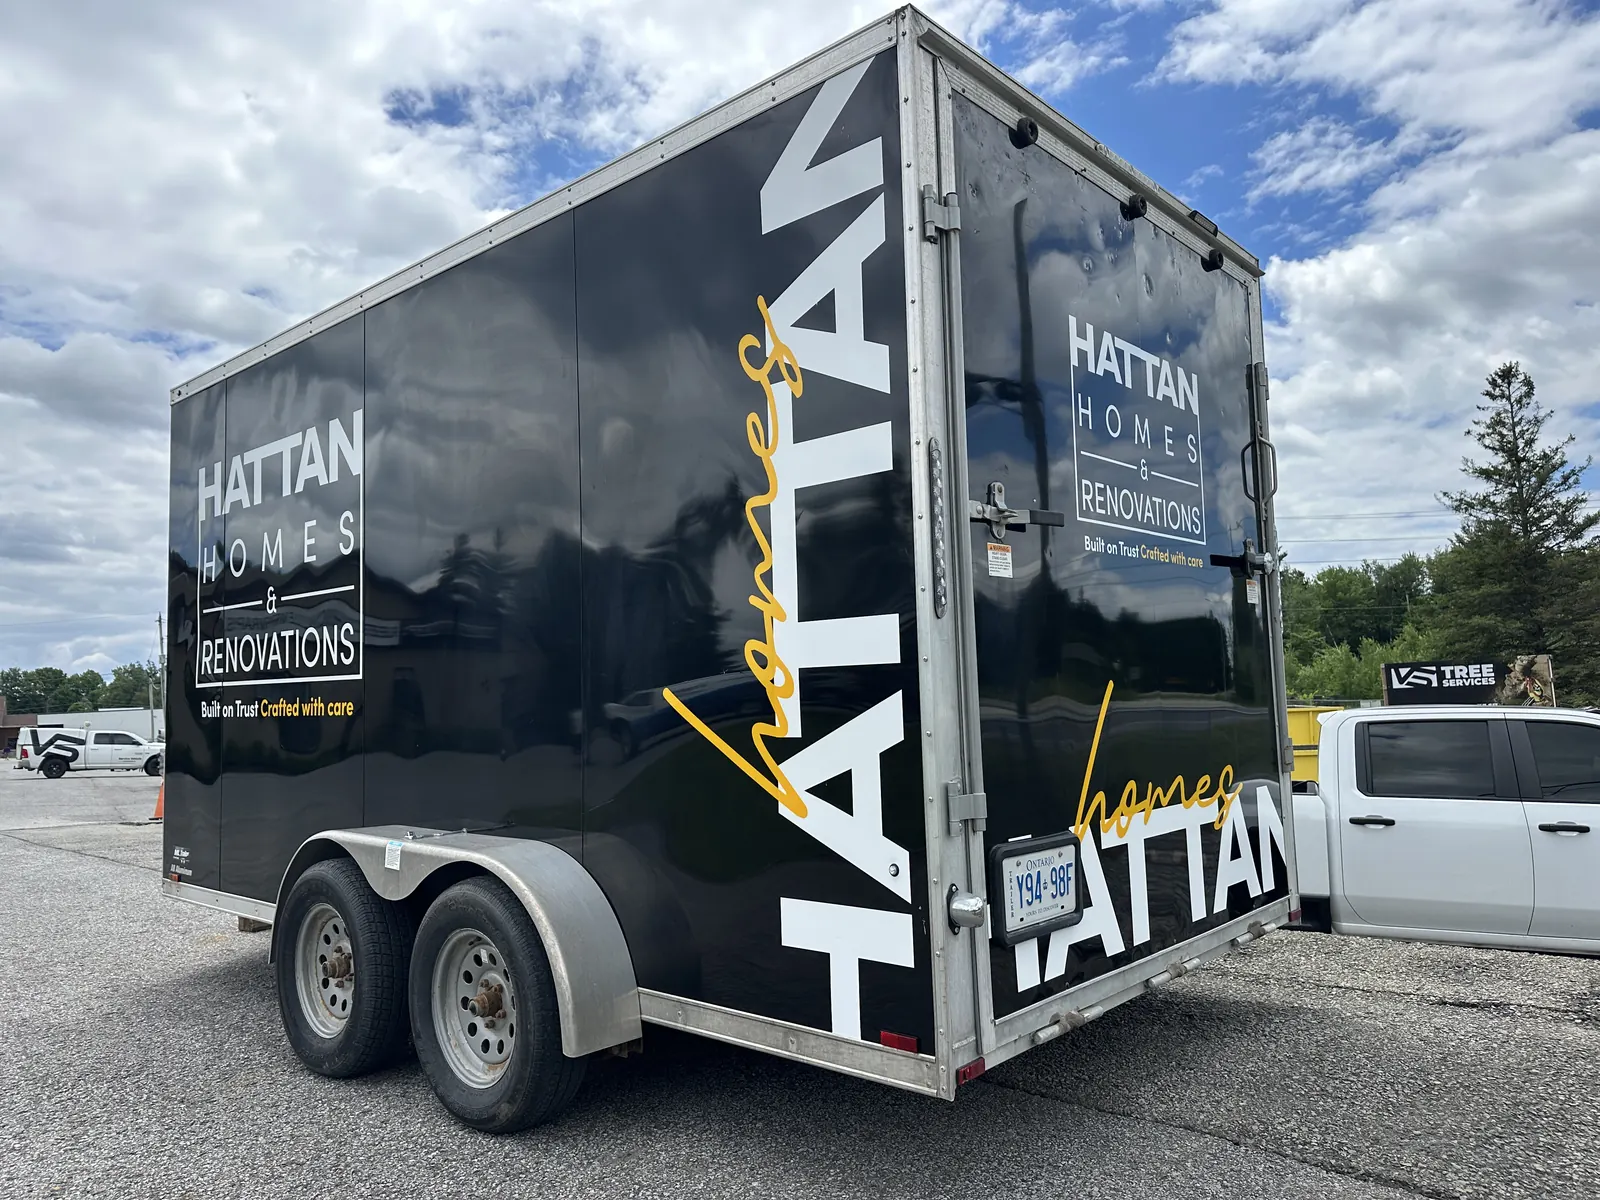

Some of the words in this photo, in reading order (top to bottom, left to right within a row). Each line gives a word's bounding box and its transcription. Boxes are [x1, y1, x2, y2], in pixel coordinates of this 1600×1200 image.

[1068, 314, 1198, 416] HATTAN
[1077, 392, 1197, 464] HOMES
[199, 408, 363, 521] HATTAN
[1140, 458, 1149, 481] &
[1081, 478, 1201, 535] RENOVATIONS
[202, 510, 355, 584] HOMES
[662, 295, 808, 819] homes
[1084, 535, 1105, 553] Built
[1106, 543, 1118, 555] on
[1118, 541, 1140, 558] Trust
[1140, 544, 1170, 563] Crafted
[1170, 550, 1187, 566] with
[1187, 555, 1204, 568] care
[266, 586, 277, 614] &
[201, 622, 355, 676] RENOVATIONS
[1440, 663, 1496, 680] TREE
[201, 701, 222, 719] Built
[222, 706, 234, 718] on
[235, 701, 259, 718] Trust
[260, 698, 299, 717] Crafted
[301, 697, 325, 717] with
[327, 702, 354, 717] care
[1442, 677, 1496, 688] SERVICES
[1073, 679, 1244, 843] homes
[987, 785, 1288, 994] ATTAN
[1026, 856, 1055, 871] ONTARIO
